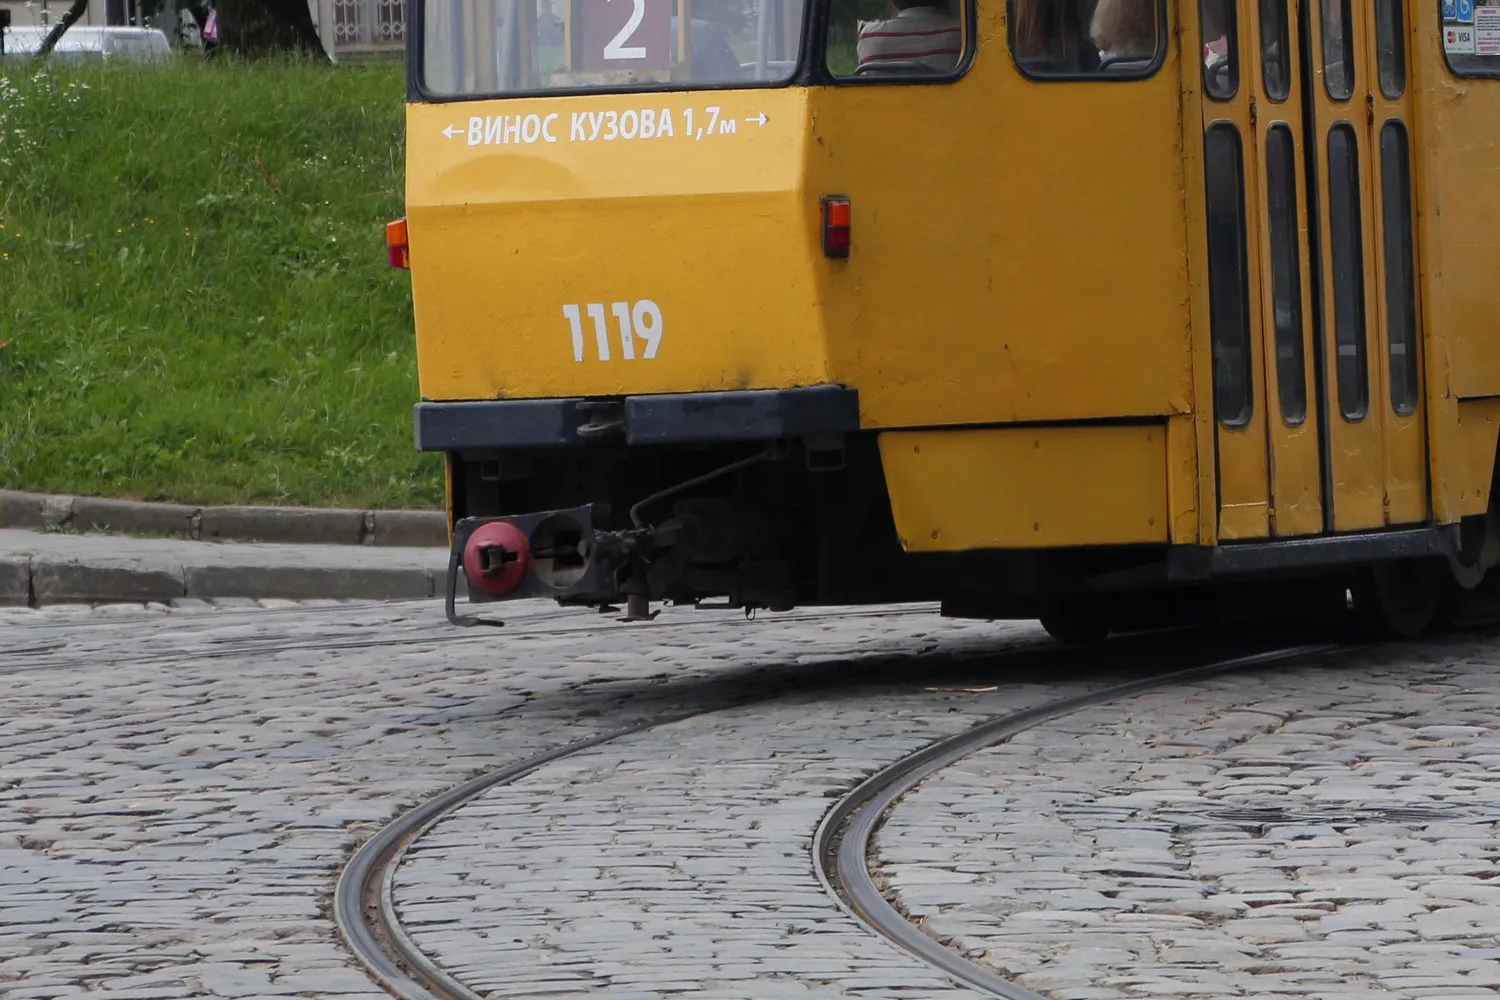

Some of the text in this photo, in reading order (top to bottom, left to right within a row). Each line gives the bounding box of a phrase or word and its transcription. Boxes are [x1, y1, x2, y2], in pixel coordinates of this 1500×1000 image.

[1458, 31, 1471, 43] VISA
[467, 106, 737, 146] ВИНОС КУЗОВА 1,7м
[563, 299, 663, 362] 1119
